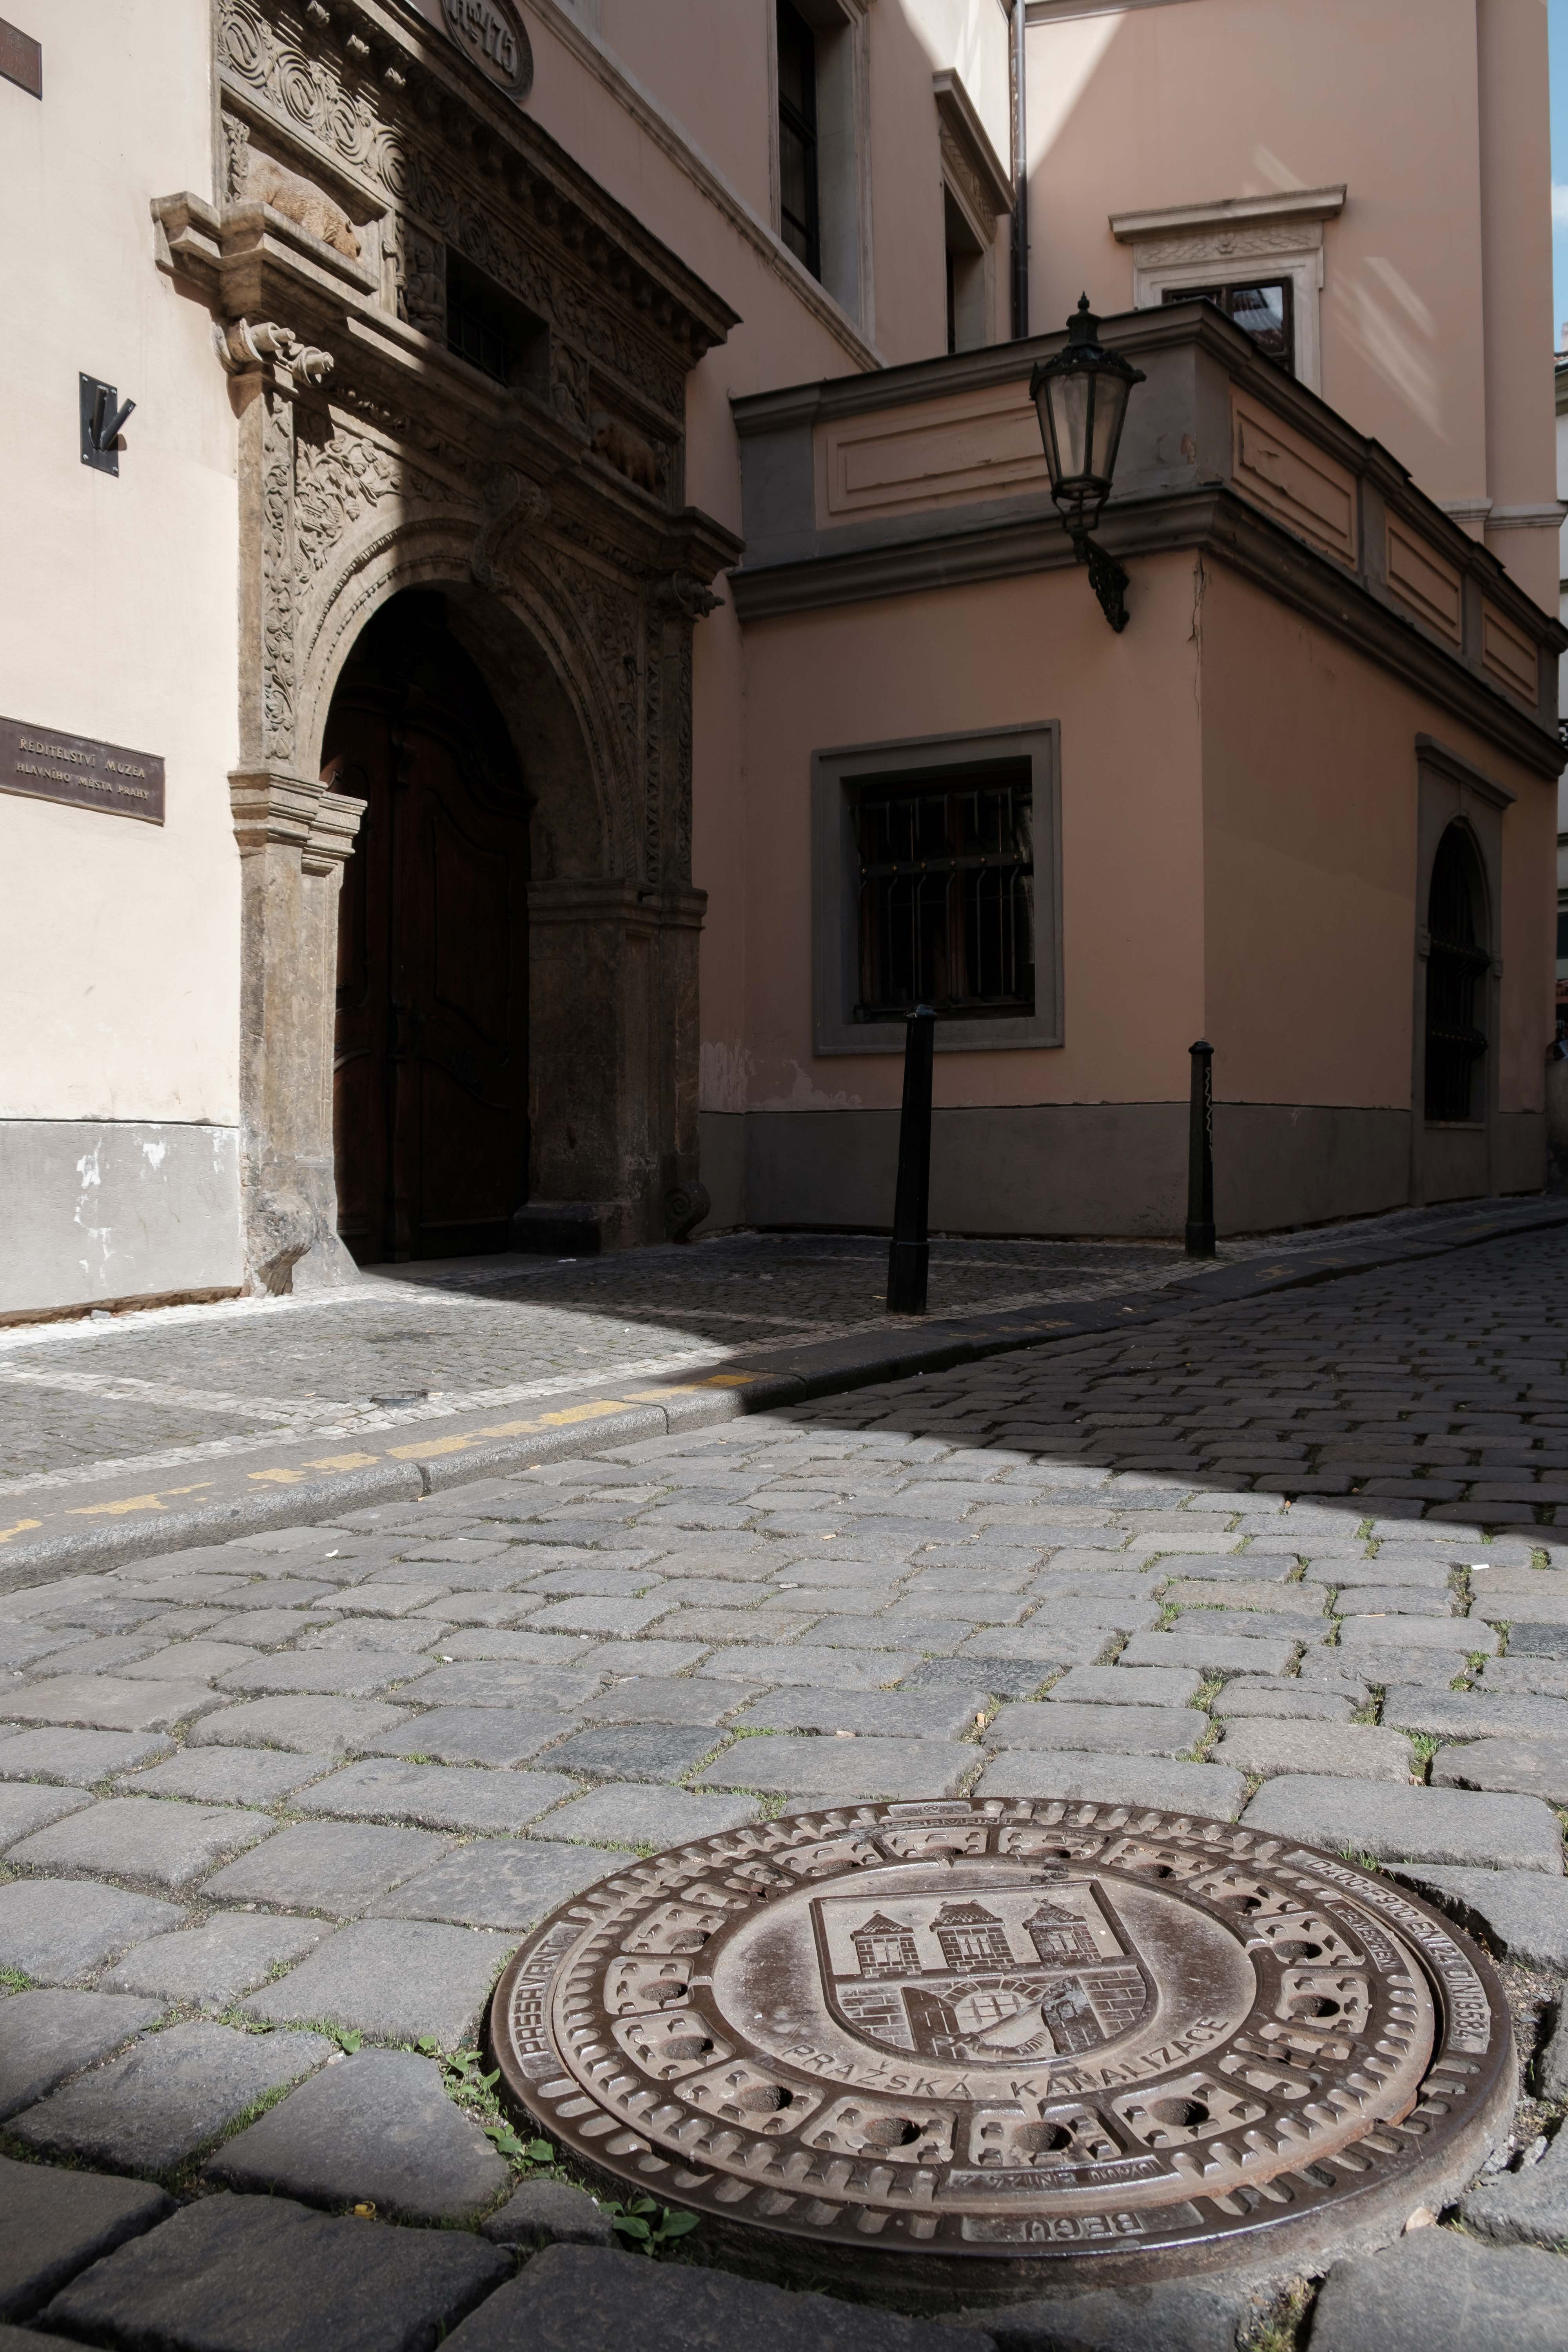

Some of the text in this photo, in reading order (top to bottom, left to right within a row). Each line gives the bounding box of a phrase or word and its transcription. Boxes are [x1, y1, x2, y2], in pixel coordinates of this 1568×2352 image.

[19, 736, 145, 779] ŘEDITELSTVÍ MUZEA
[16, 762, 149, 800] HLAVNÍHO MĚSTA PRAHY
[514, 1940, 561, 2058] PASSAVANT
[782, 2016, 1230, 2100] PRAŽSKÁ KANALIZACE
[1024, 2212, 1144, 2241] BEGU
